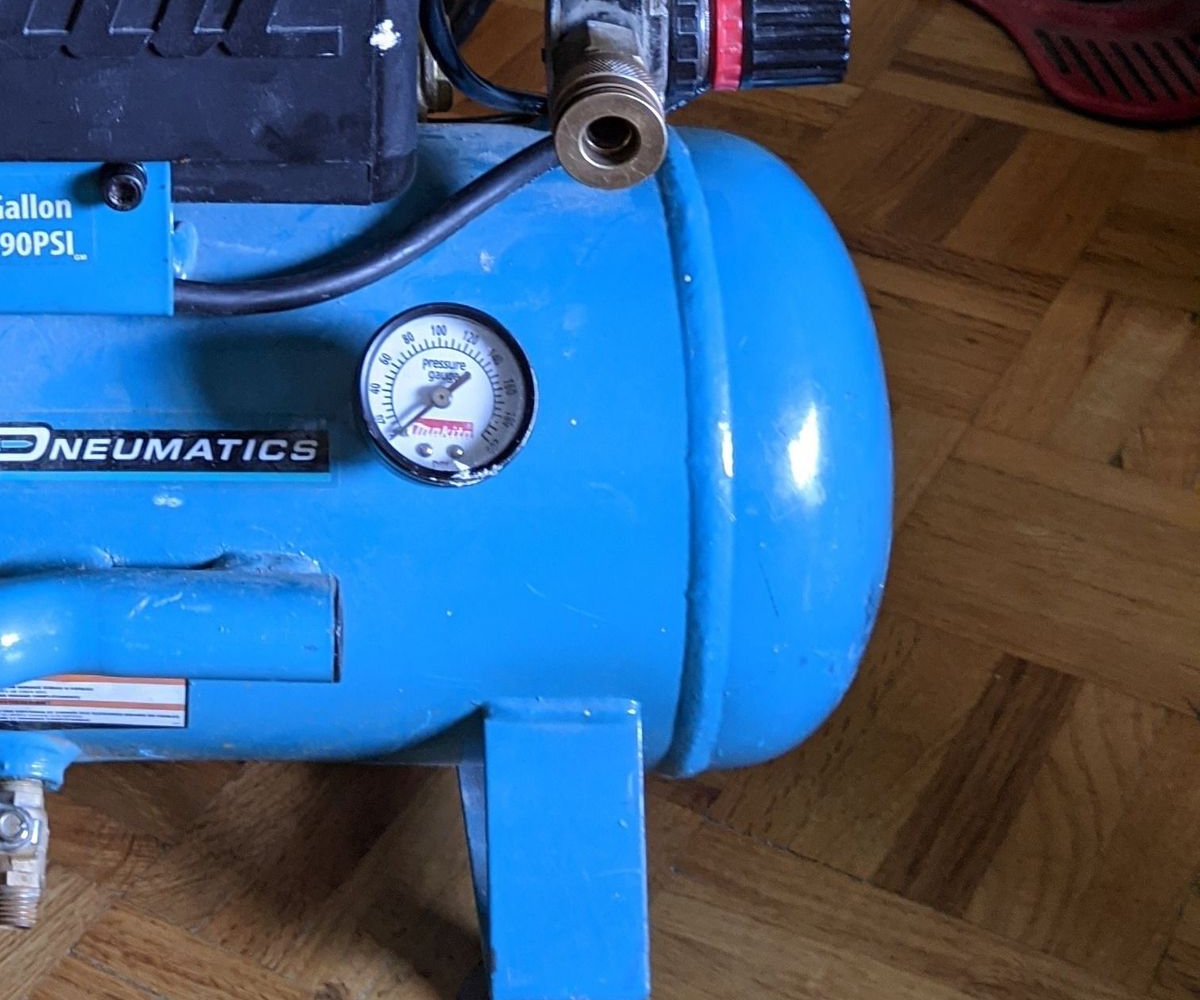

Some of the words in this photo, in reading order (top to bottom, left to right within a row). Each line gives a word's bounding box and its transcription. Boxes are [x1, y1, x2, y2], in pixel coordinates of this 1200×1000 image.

[430, 324, 448, 336] 100
[377, 352, 392, 366] 60
[422, 357, 467, 372] pressure
